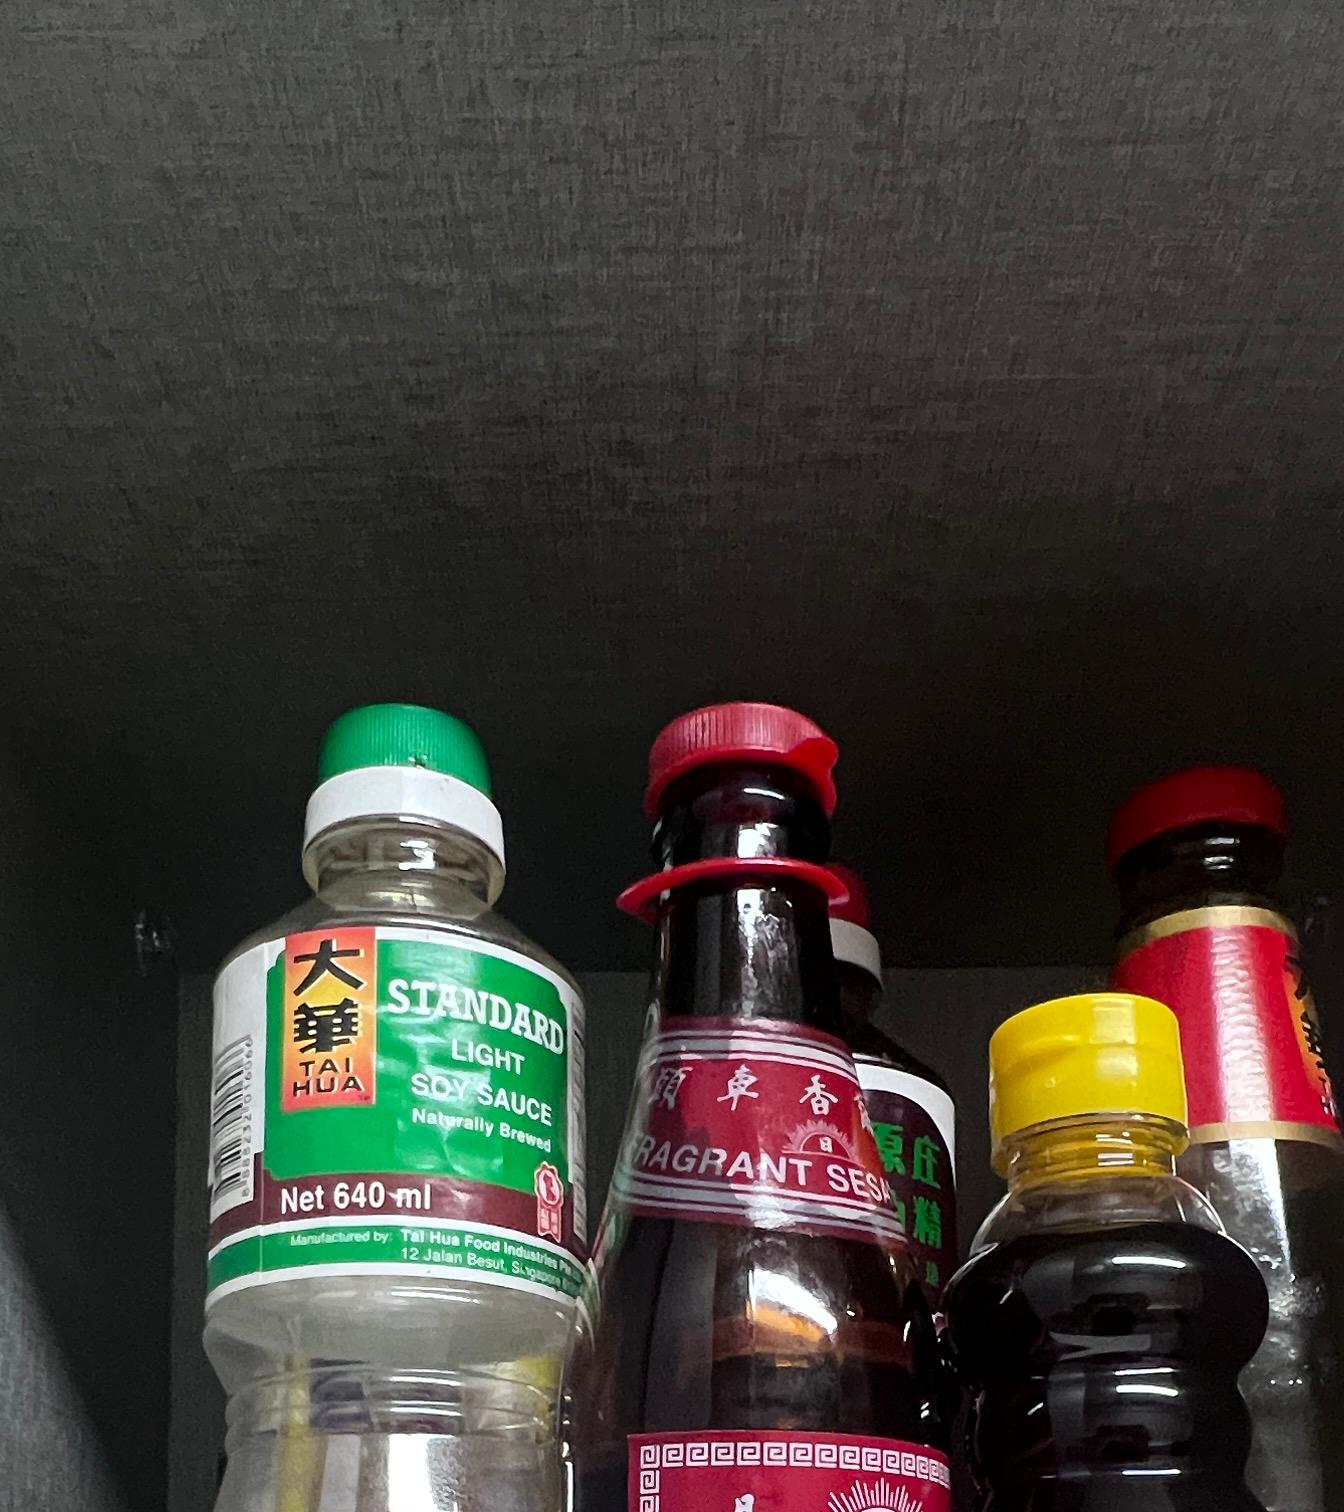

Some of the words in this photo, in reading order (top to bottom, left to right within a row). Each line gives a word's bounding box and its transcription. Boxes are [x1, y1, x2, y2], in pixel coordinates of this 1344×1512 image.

[293, 939, 365, 1054] 大華
[387, 978, 565, 1056] STANDARD
[299, 1058, 353, 1078] TAI
[451, 1039, 525, 1076] LIGHT
[293, 1076, 365, 1099] HUA
[411, 1071, 471, 1101] SOY
[476, 1081, 553, 1127] SAUCE
[411, 1107, 494, 1138] Naturally
[499, 1121, 552, 1153] Brewed
[627, 1134, 813, 1187] RAGRANT
[826, 1164, 892, 1204] SESA
[281, 1183, 325, 1215] Net
[333, 1181, 386, 1210] 640
[395, 1183, 432, 1211] ml
[290, 1231, 371, 1247] Manufactured
[400, 1228, 425, 1243] Tai
[429, 1231, 461, 1246] Hua
[464, 1233, 501, 1252] Food
[401, 1247, 419, 1261] 12
[422, 1248, 463, 1264] Jalan
